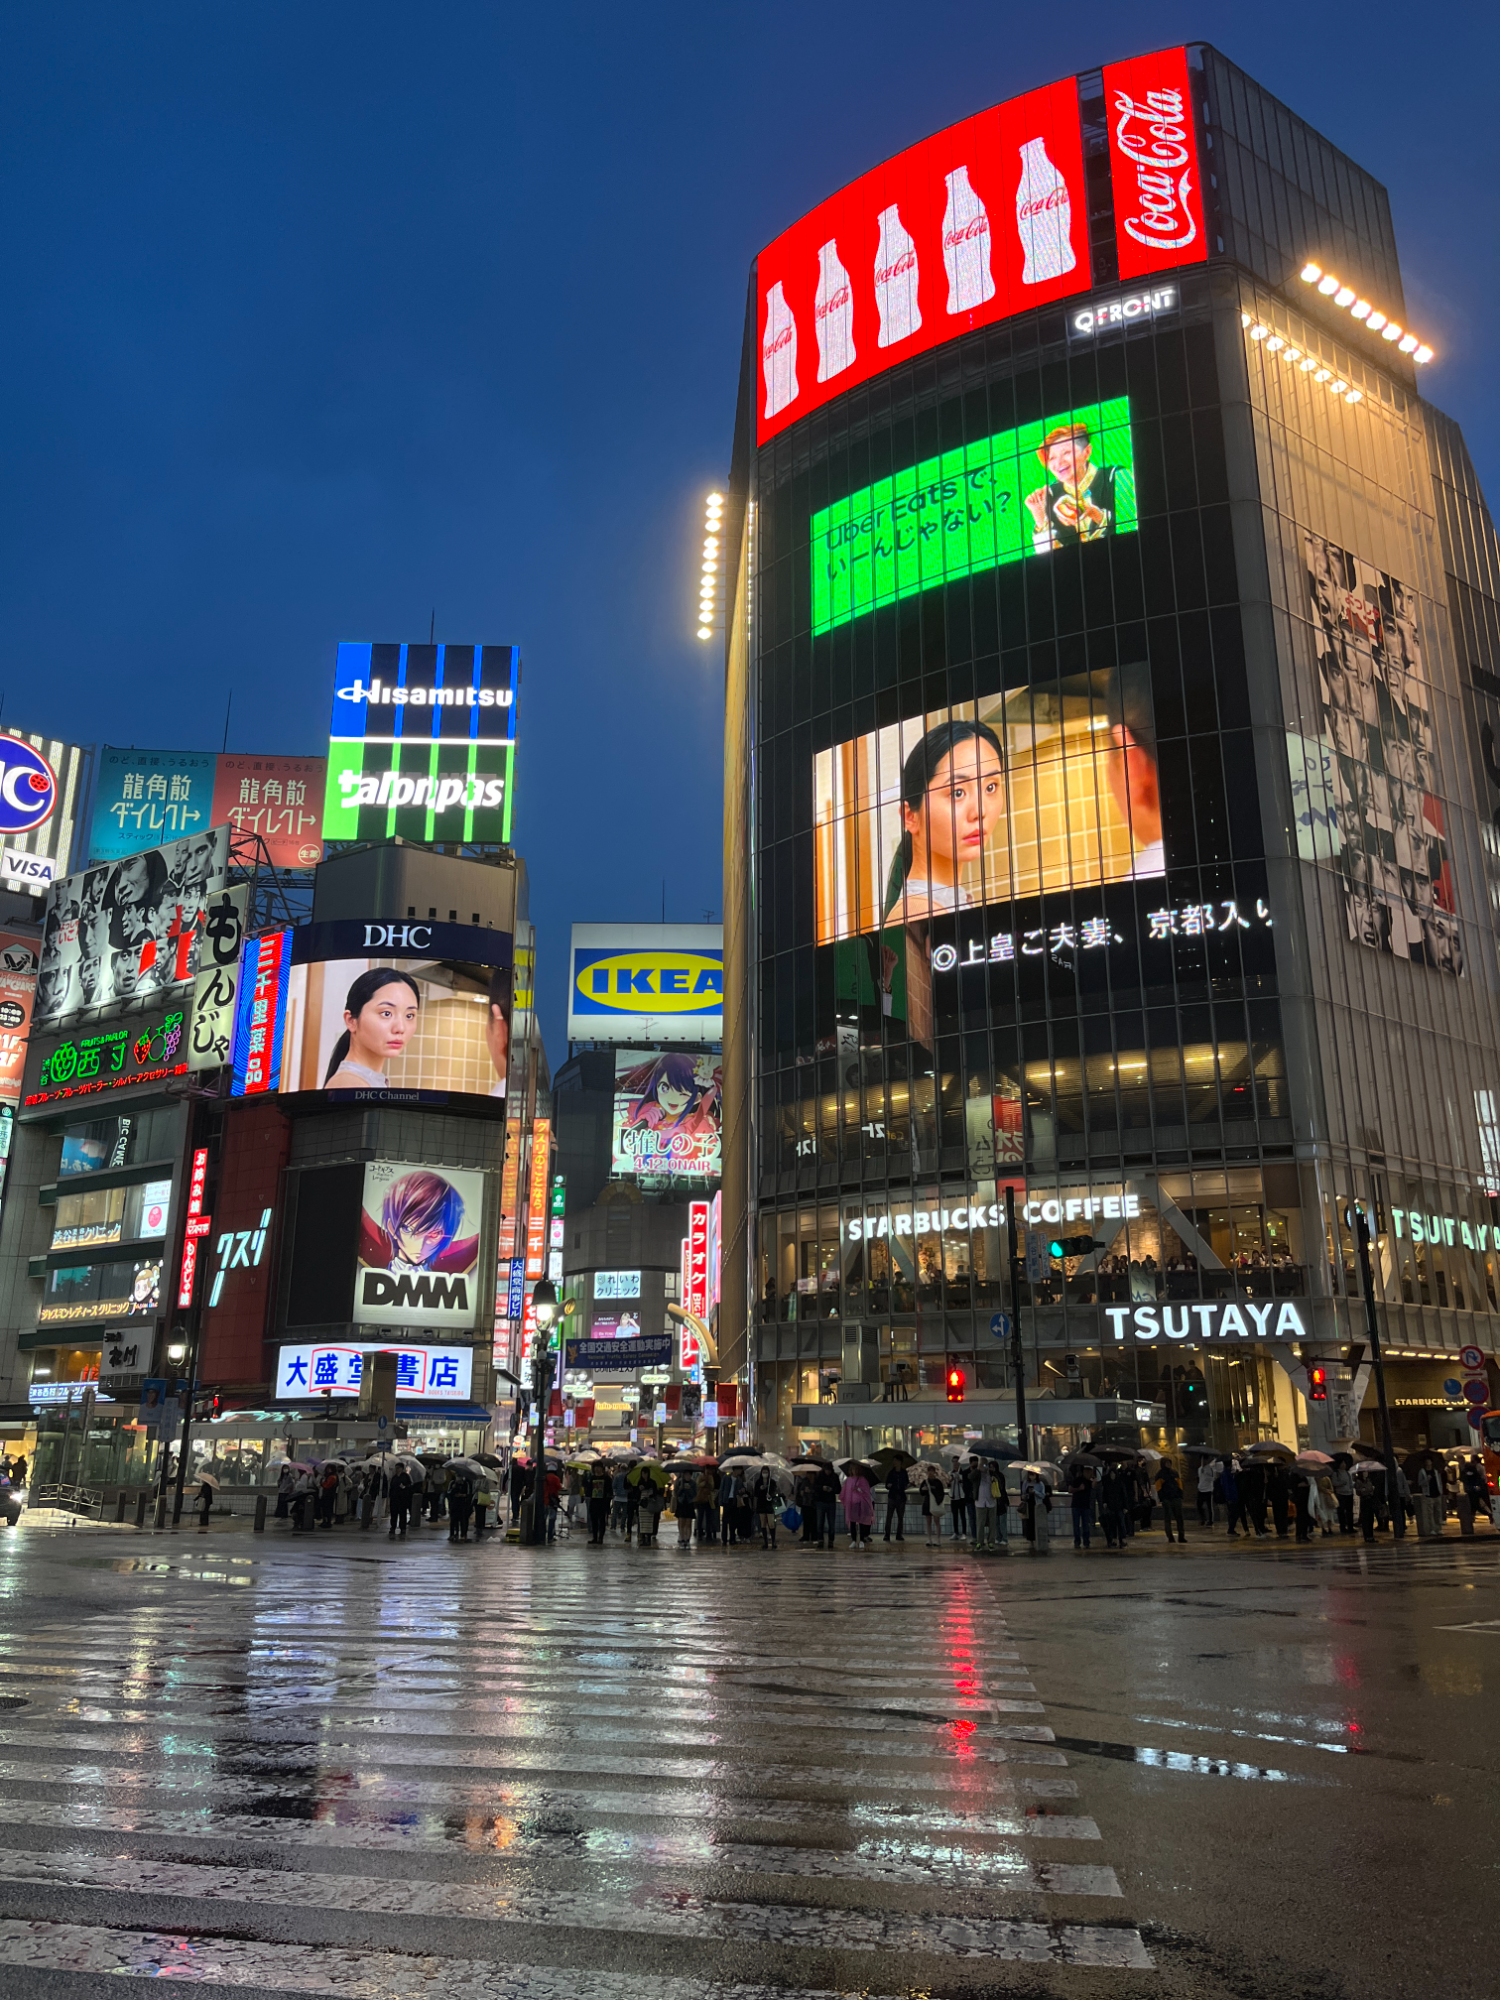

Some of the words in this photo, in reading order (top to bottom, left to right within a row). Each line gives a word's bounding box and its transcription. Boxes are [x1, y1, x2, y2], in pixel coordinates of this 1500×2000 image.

[1074, 287, 1178, 333] QFRONT
[825, 506, 885, 552] Uber
[891, 480, 958, 522] Eats
[122, 773, 192, 801] 龍角散
[239, 778, 307, 806] 龍角散
[110, 802, 201, 831] ダイレクト
[227, 807, 316, 835] ダイレクト
[6, 855, 53, 881] VISA
[362, 924, 432, 949] DHC
[193, 892, 242, 1063] もんじゃ
[592, 968, 723, 994] IKEA
[244, 938, 276, 1084] 三千里薬品
[354, 1090, 378, 1100] DHC
[379, 1091, 419, 1101] Channel
[532, 1122, 547, 1210] クスリのことなら
[848, 1203, 1006, 1240] STARBUCKS
[1022, 1194, 1140, 1224] COFFEE
[527, 1216, 544, 1273] 三千里
[691, 1212, 707, 1285] カラオケ
[362, 1272, 469, 1310] DMM
[596, 1287, 639, 1296] クリニック
[607, 1274, 639, 1284] れいわ
[1105, 1302, 1306, 1340] TSUTAYA
[1395, 1398, 1447, 1406] STARBUCKS
